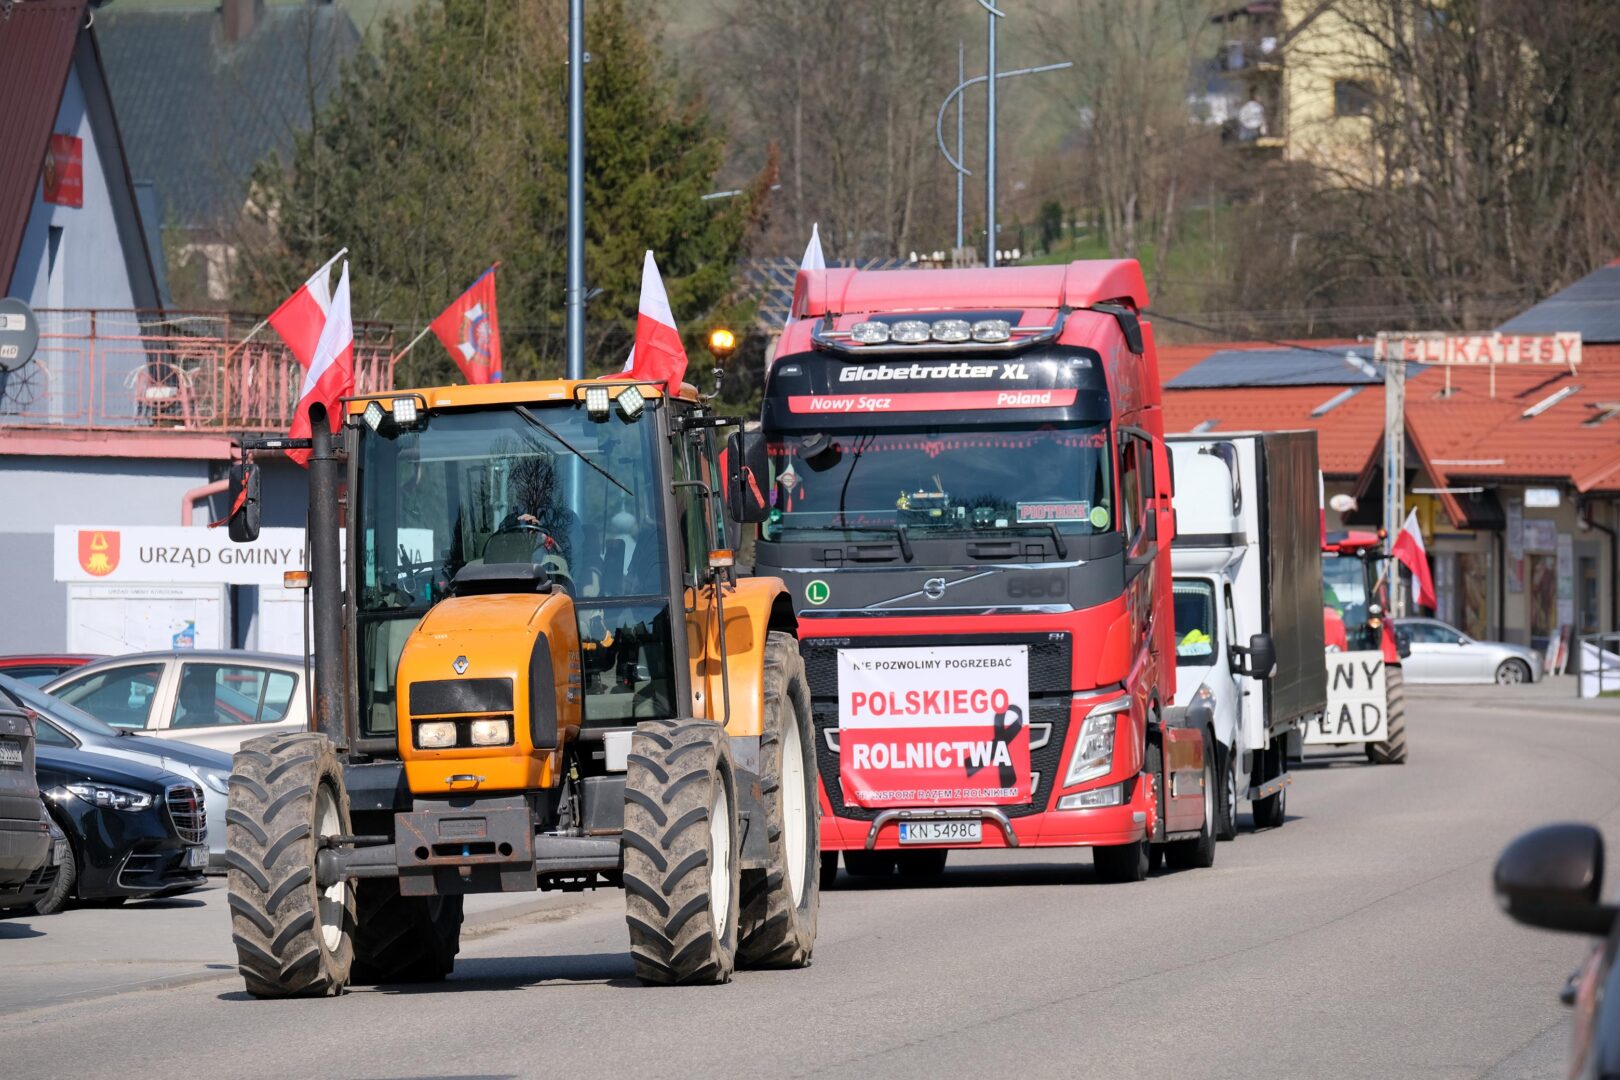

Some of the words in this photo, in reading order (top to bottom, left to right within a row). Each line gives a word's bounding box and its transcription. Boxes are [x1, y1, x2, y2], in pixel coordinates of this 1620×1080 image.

[1382, 336, 1575, 361] ELIKATESY
[839, 363, 998, 382] Globetrotter
[999, 363, 1029, 381] XL
[810, 397, 854, 412] Nowy
[857, 396, 892, 412] Sącz
[997, 391, 1052, 406] Poland
[139, 547, 211, 567] URZĄD
[218, 547, 290, 565] GMINY
[853, 661, 872, 671] NE
[875, 660, 941, 671] POZWOLIMY
[945, 657, 1012, 669] POGRZEBAĆ
[851, 688, 1009, 717] POLSKIEGO
[852, 741, 1012, 770] ROLNICTWA
[917, 789, 952, 800] RAZEM
[954, 789, 962, 799] Z
[963, 787, 1018, 798] ROLNIKIEM
[909, 824, 928, 838] KN
[933, 823, 977, 838] 5498C
